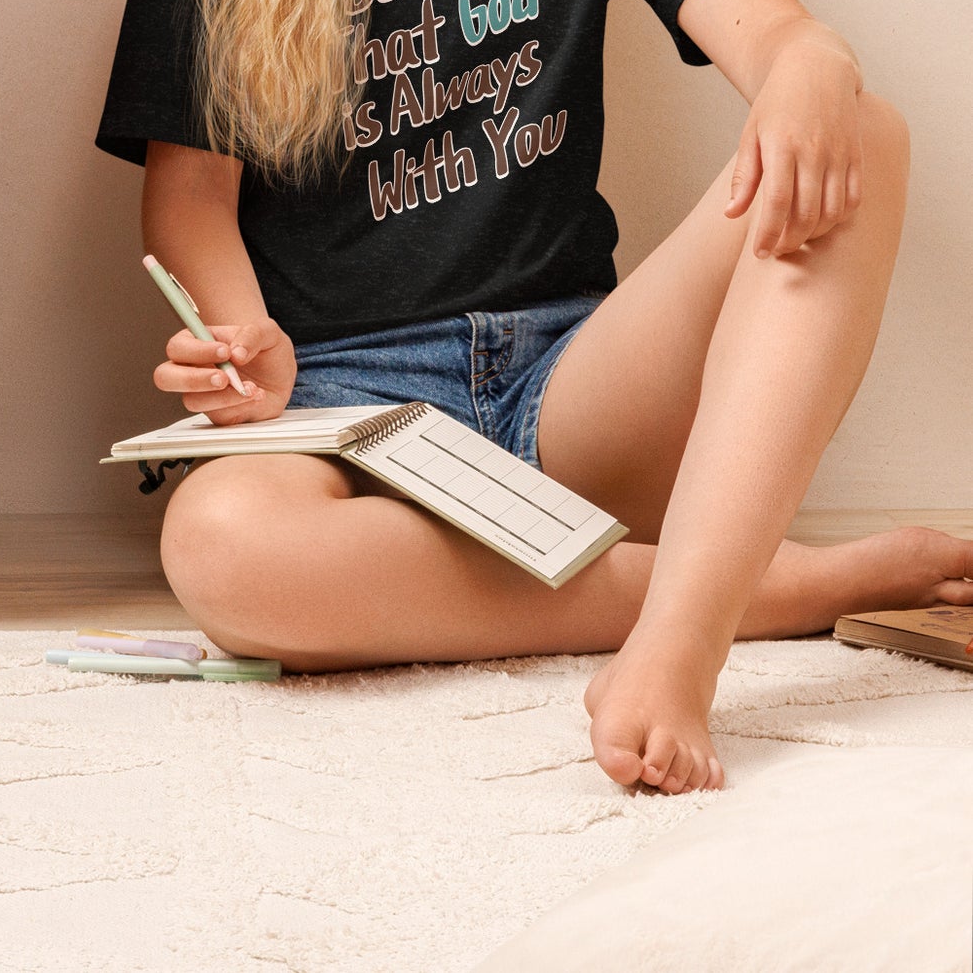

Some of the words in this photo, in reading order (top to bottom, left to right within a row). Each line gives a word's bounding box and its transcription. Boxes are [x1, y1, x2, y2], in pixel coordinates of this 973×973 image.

[342, 101, 383, 151] is
[389, 40, 542, 135] Always
[368, 130, 478, 221] With
[482, 106, 568, 179] You
